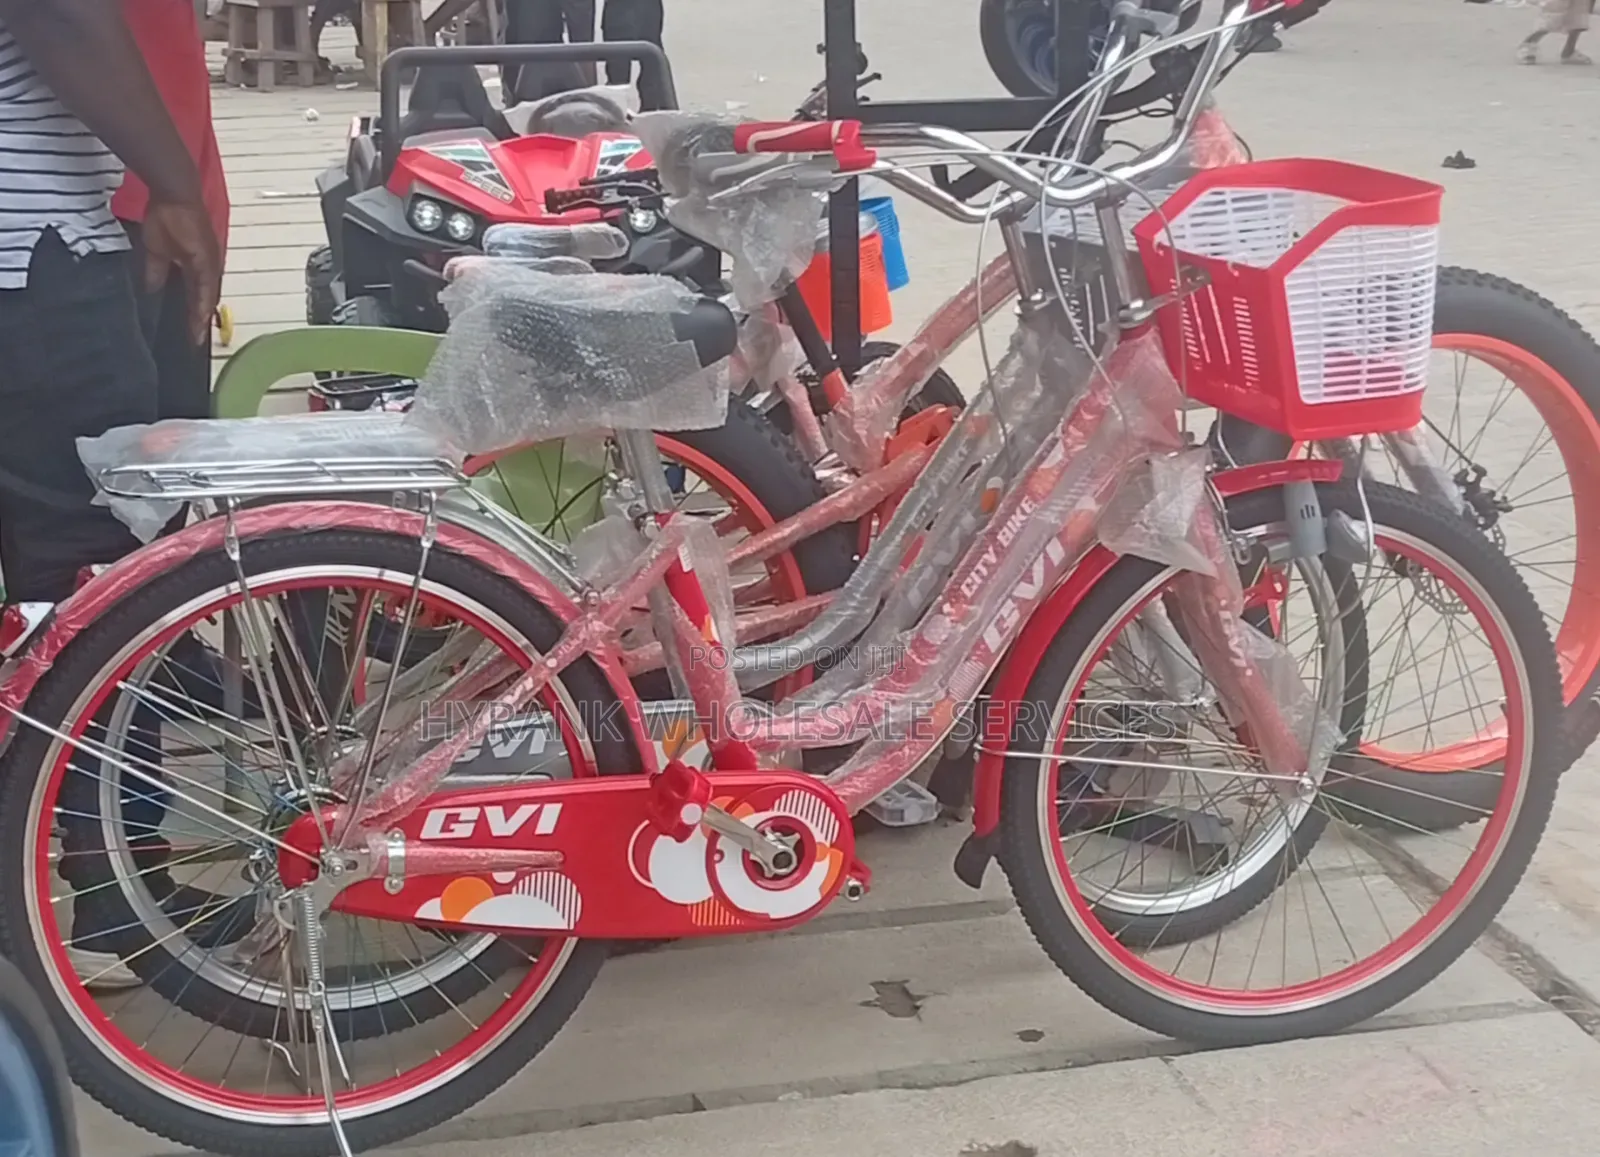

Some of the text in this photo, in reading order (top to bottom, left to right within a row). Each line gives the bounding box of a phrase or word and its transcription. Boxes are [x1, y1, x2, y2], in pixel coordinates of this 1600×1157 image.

[463, 170, 514, 202] SPEED
[960, 496, 1039, 599] CITY BIKE
[981, 536, 1066, 653] GVI
[454, 718, 550, 763] VI
[419, 802, 564, 841] GVI
